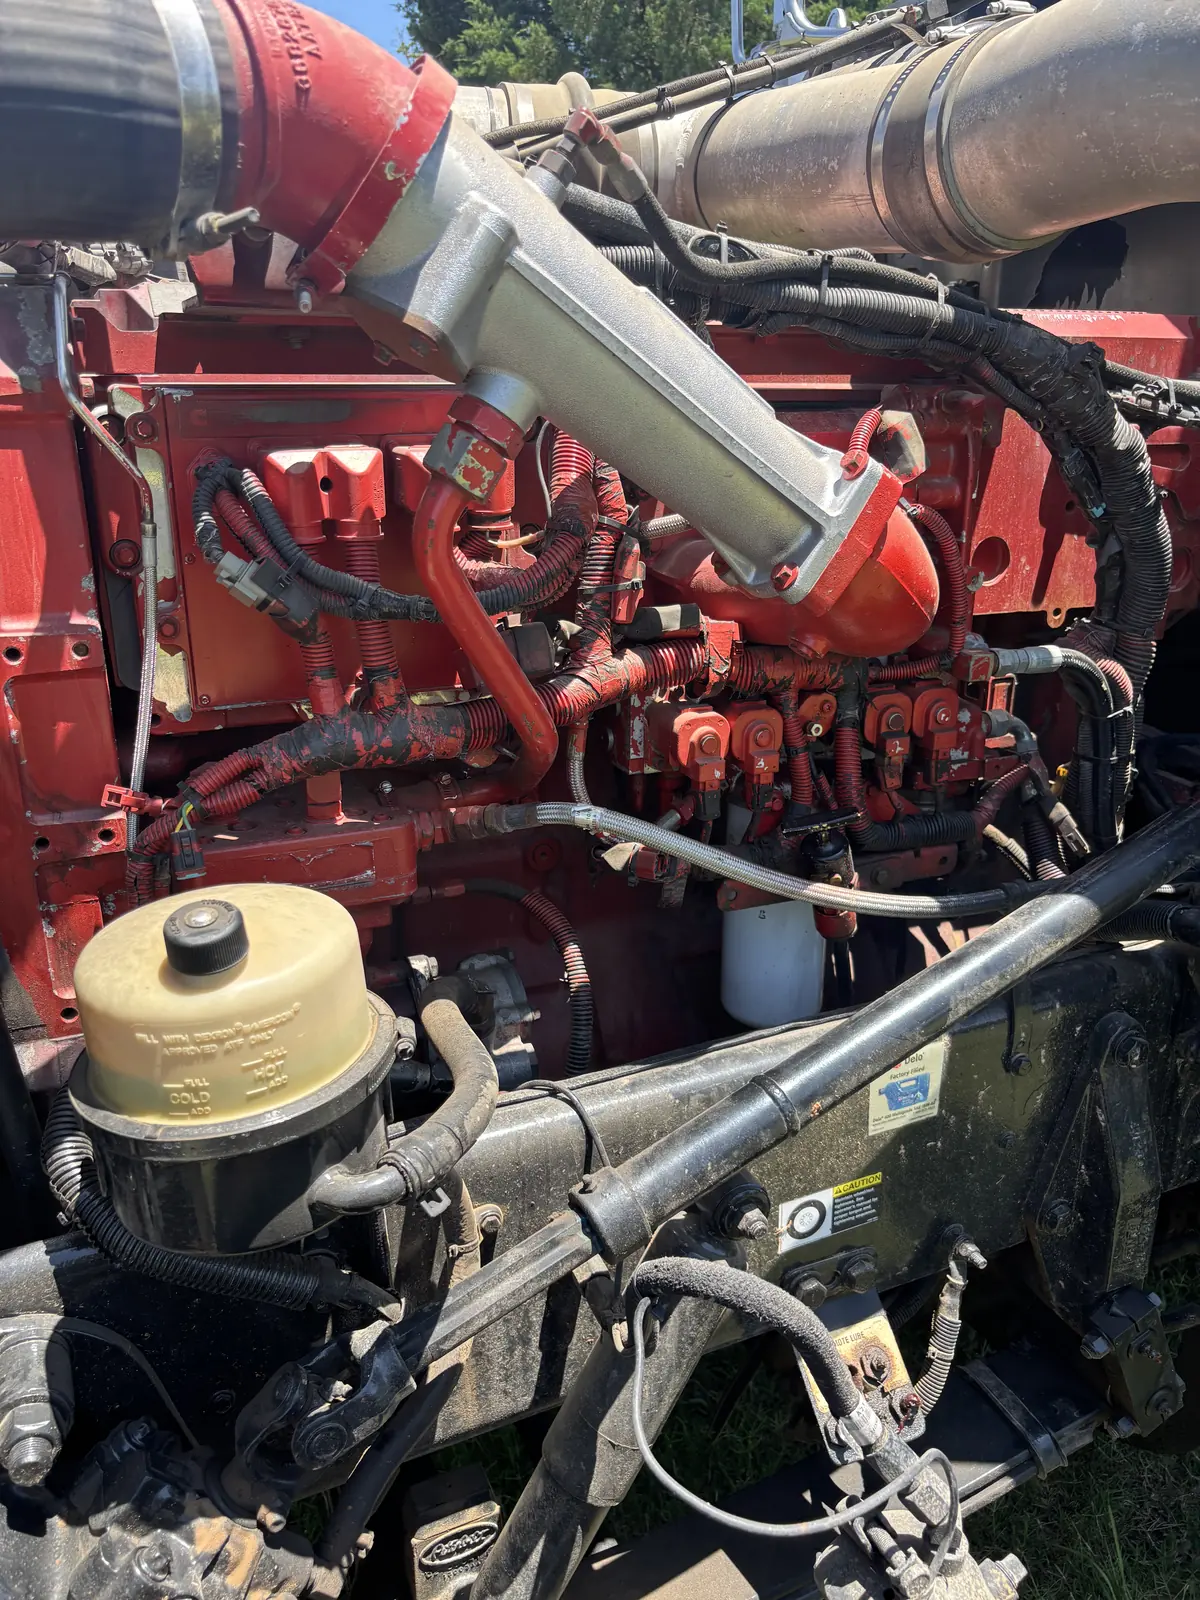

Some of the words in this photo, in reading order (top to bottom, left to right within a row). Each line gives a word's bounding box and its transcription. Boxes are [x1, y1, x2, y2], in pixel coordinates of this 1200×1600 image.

[162, 1032, 190, 1044] WITH
[162, 1045, 218, 1056] APPROVED
[224, 1037, 245, 1051] ATF
[249, 1028, 276, 1045] ONLY
[264, 1045, 288, 1059] FULL
[254, 1060, 285, 1079] HOT
[184, 1078, 210, 1087] FULL
[268, 1075, 289, 1089] ADD
[169, 1091, 211, 1105] COLD
[190, 1106, 212, 1116] ADD
[842, 1174, 881, 1192] CAUTION
[850, 1330, 865, 1342] LUBE
